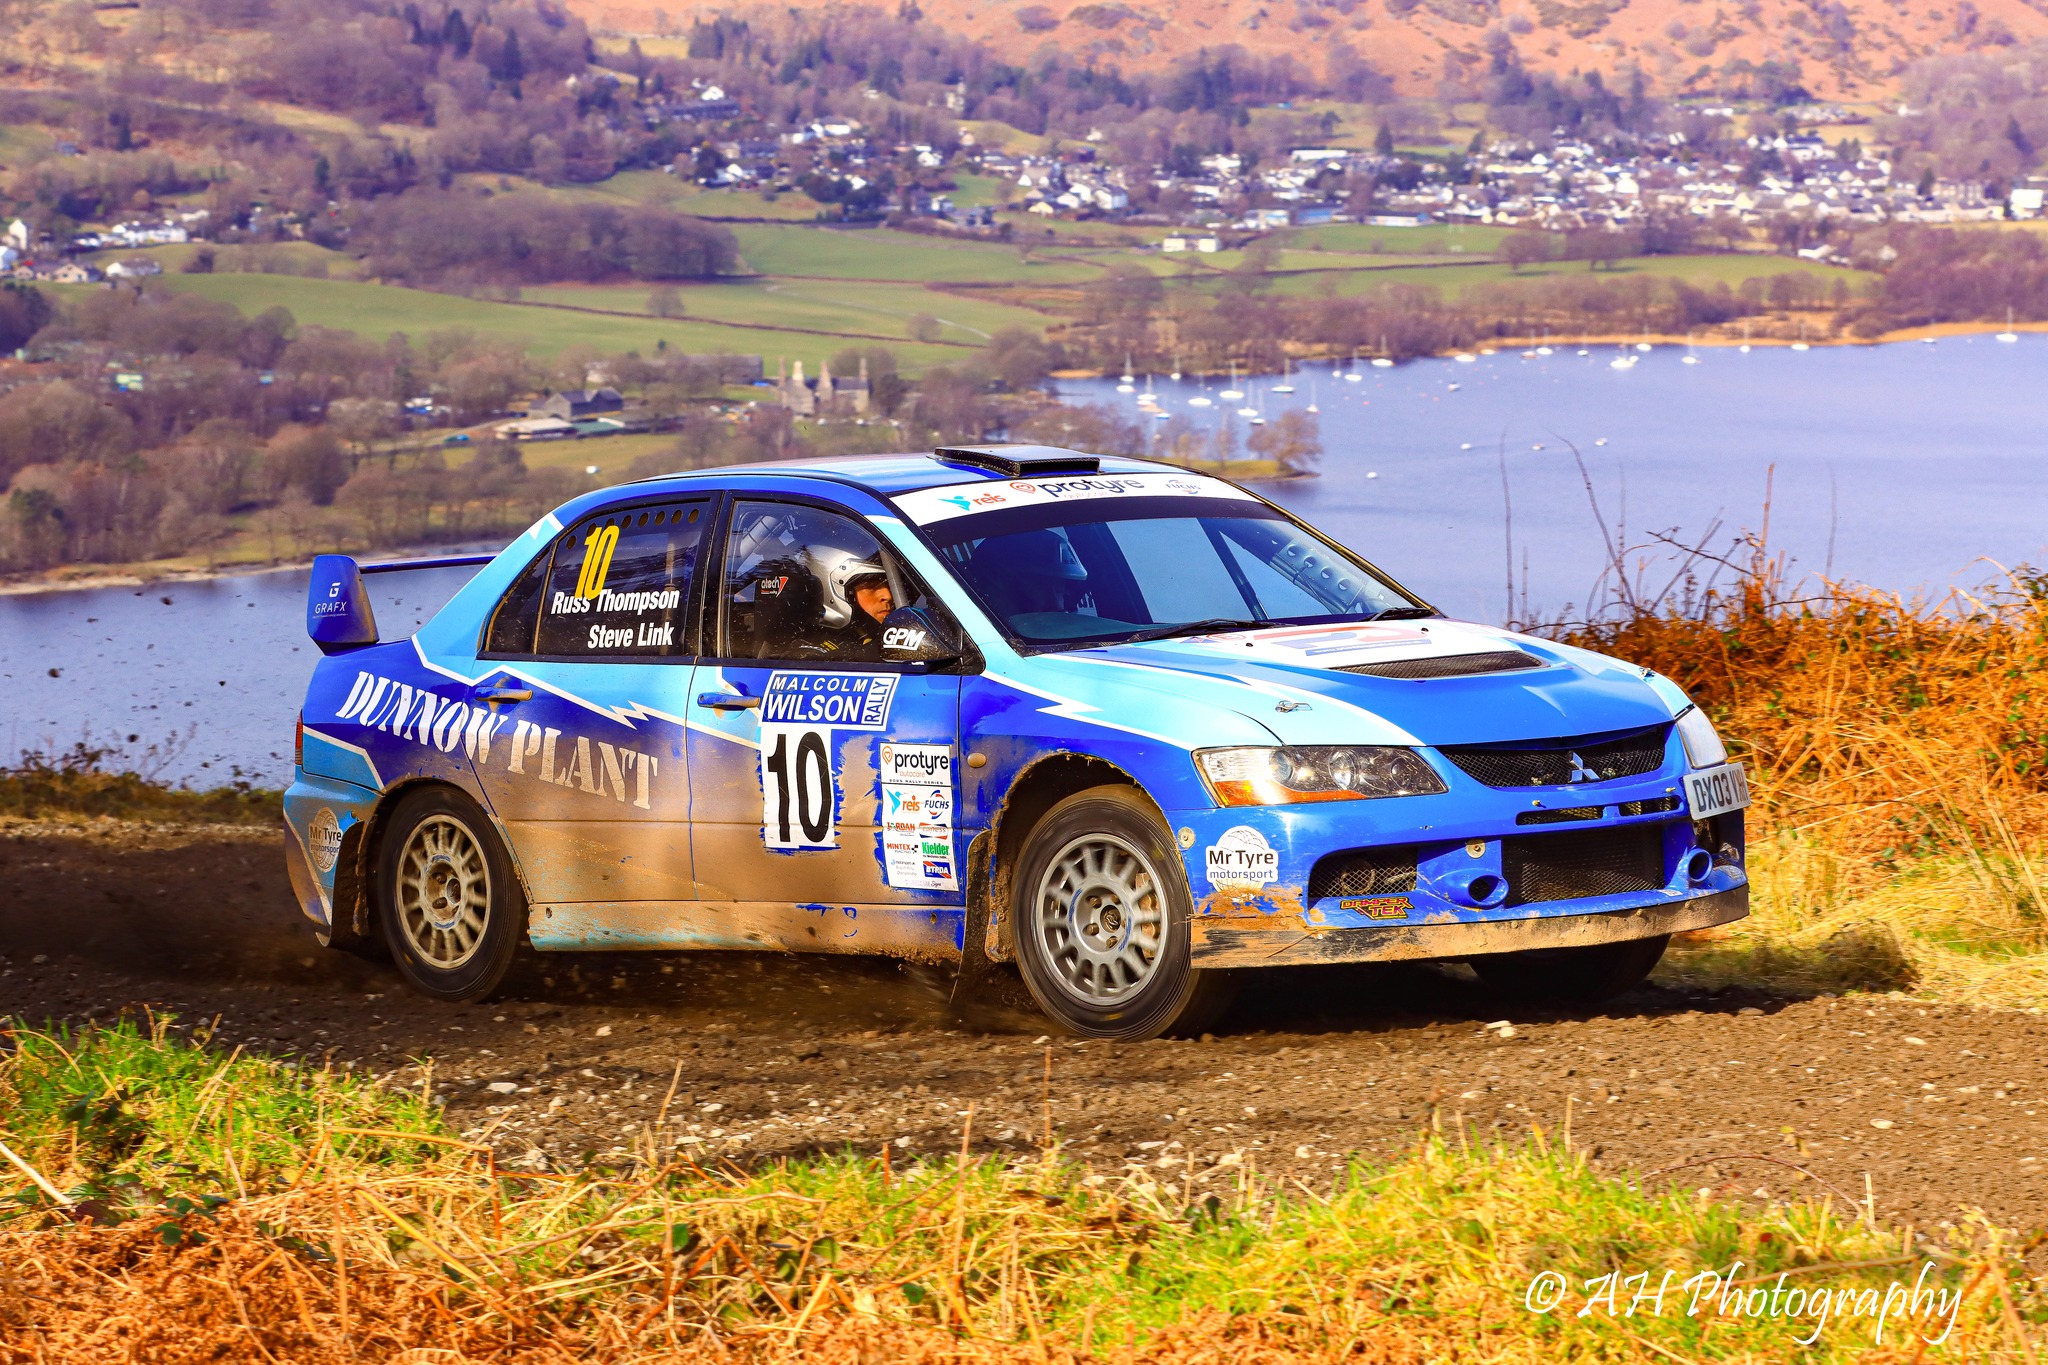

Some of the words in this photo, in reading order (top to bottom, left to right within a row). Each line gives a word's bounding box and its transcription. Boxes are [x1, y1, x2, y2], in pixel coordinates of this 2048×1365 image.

[1037, 477, 1144, 497] protyre
[1165, 483, 1201, 491] FUCHS
[973, 493, 1007, 506] reis
[575, 525, 620, 600] 10
[315, 601, 347, 614] GRAFX
[551, 591, 591, 615] Russ
[596, 588, 680, 615] Thompson
[587, 624, 634, 648] Steve
[637, 622, 675, 646] Link
[883, 627, 926, 649] GPM
[772, 676, 869, 692] MALCOLM
[767, 693, 862, 722] WILSON
[864, 681, 889, 722] RALLY
[335, 671, 508, 764] DUNNOW
[507, 720, 658, 809] PLANT
[894, 751, 949, 775] protyre
[899, 770, 926, 778] autocare
[767, 731, 832, 843] 10
[1692, 773, 1732, 812] DX03
[902, 795, 920, 812] reis
[924, 800, 950, 810] FUCHS
[310, 826, 321, 839] Mr
[323, 828, 342, 844] Tyre
[310, 843, 339, 853] motorspor
[887, 843, 911, 851] MINTEX
[922, 842, 950, 855] Kielder
[1209, 851, 1232, 865] Mr
[1235, 851, 1274, 868] Tyre
[1210, 869, 1273, 882] motorsport
[1368, 905, 1406, 916] TEK
